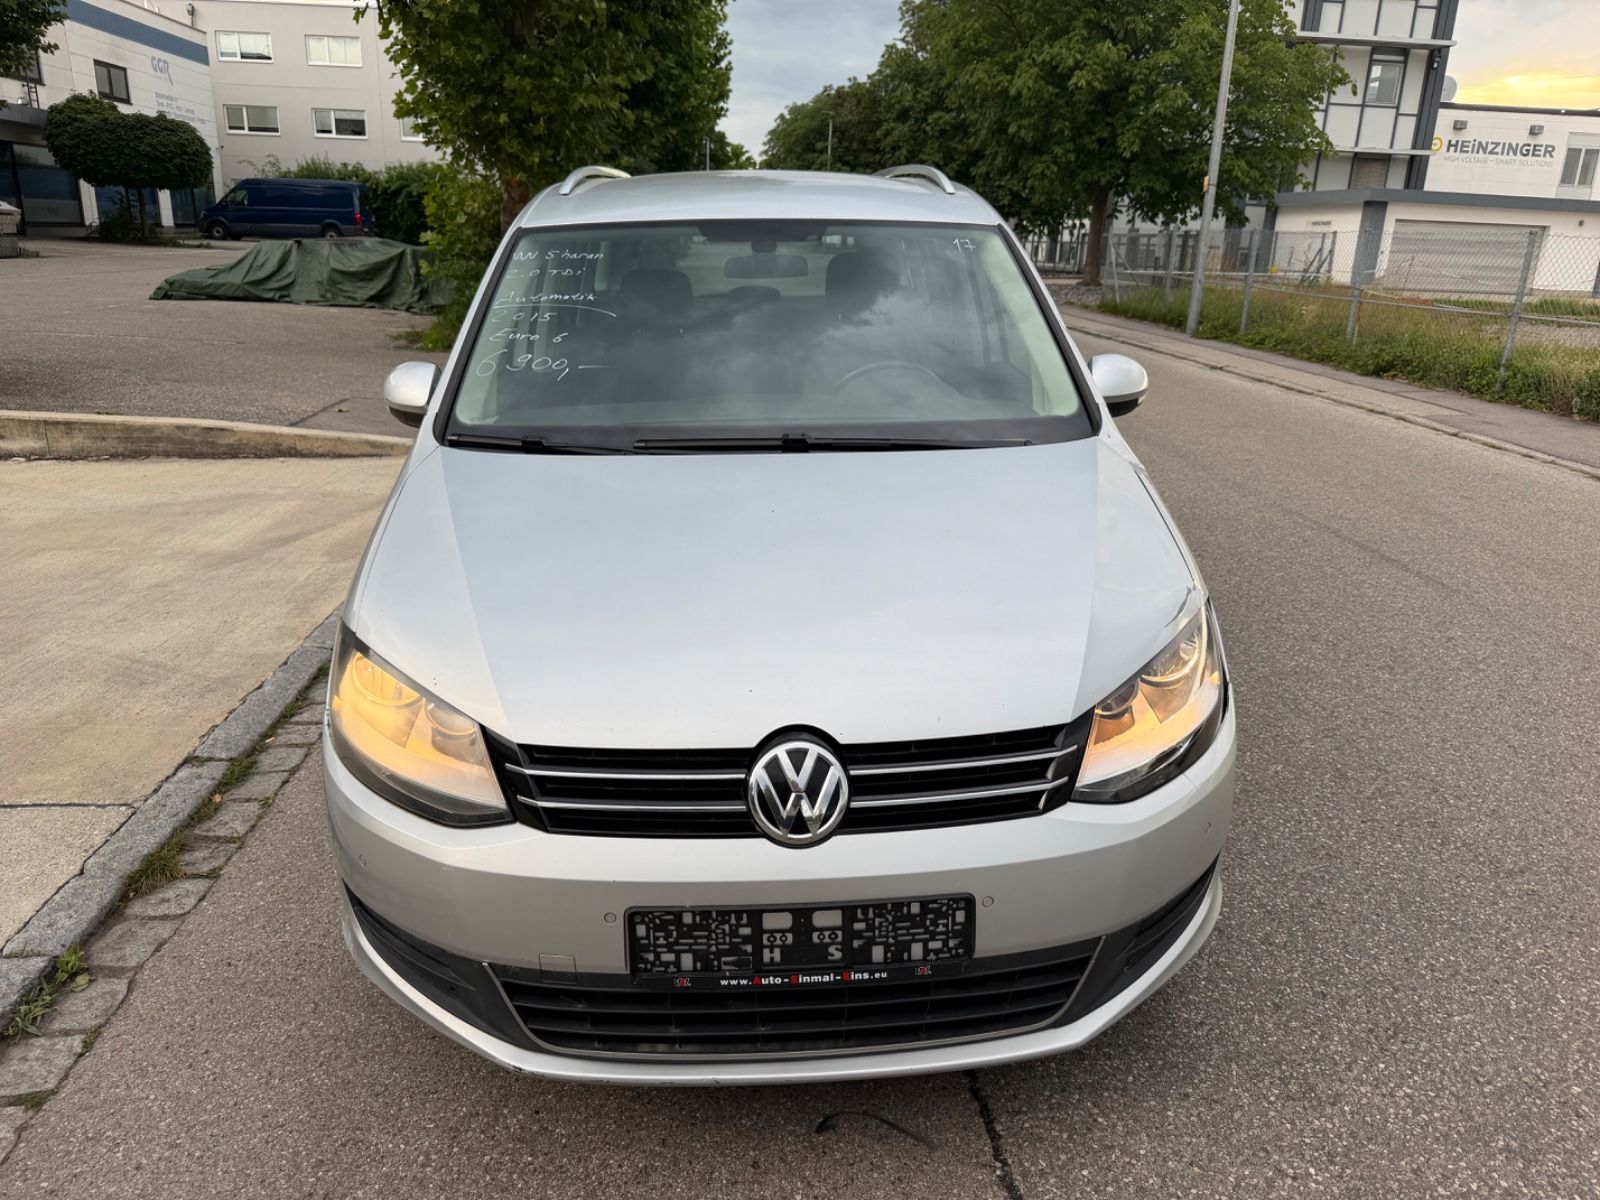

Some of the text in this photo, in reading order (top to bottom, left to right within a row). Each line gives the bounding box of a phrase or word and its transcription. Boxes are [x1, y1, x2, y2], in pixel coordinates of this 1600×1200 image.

[1461, 156, 1488, 165] VOLTAGE
[1495, 157, 1517, 166] SMART
[1519, 158, 1554, 168] SOLUTIONS
[952, 238, 976, 252] 17
[506, 269, 540, 279] 2.0
[491, 310, 557, 322] 2015
[490, 327, 569, 343] Euro 6
[720, 971, 888, 986] www.Auto-Einmal-Eins.eu
